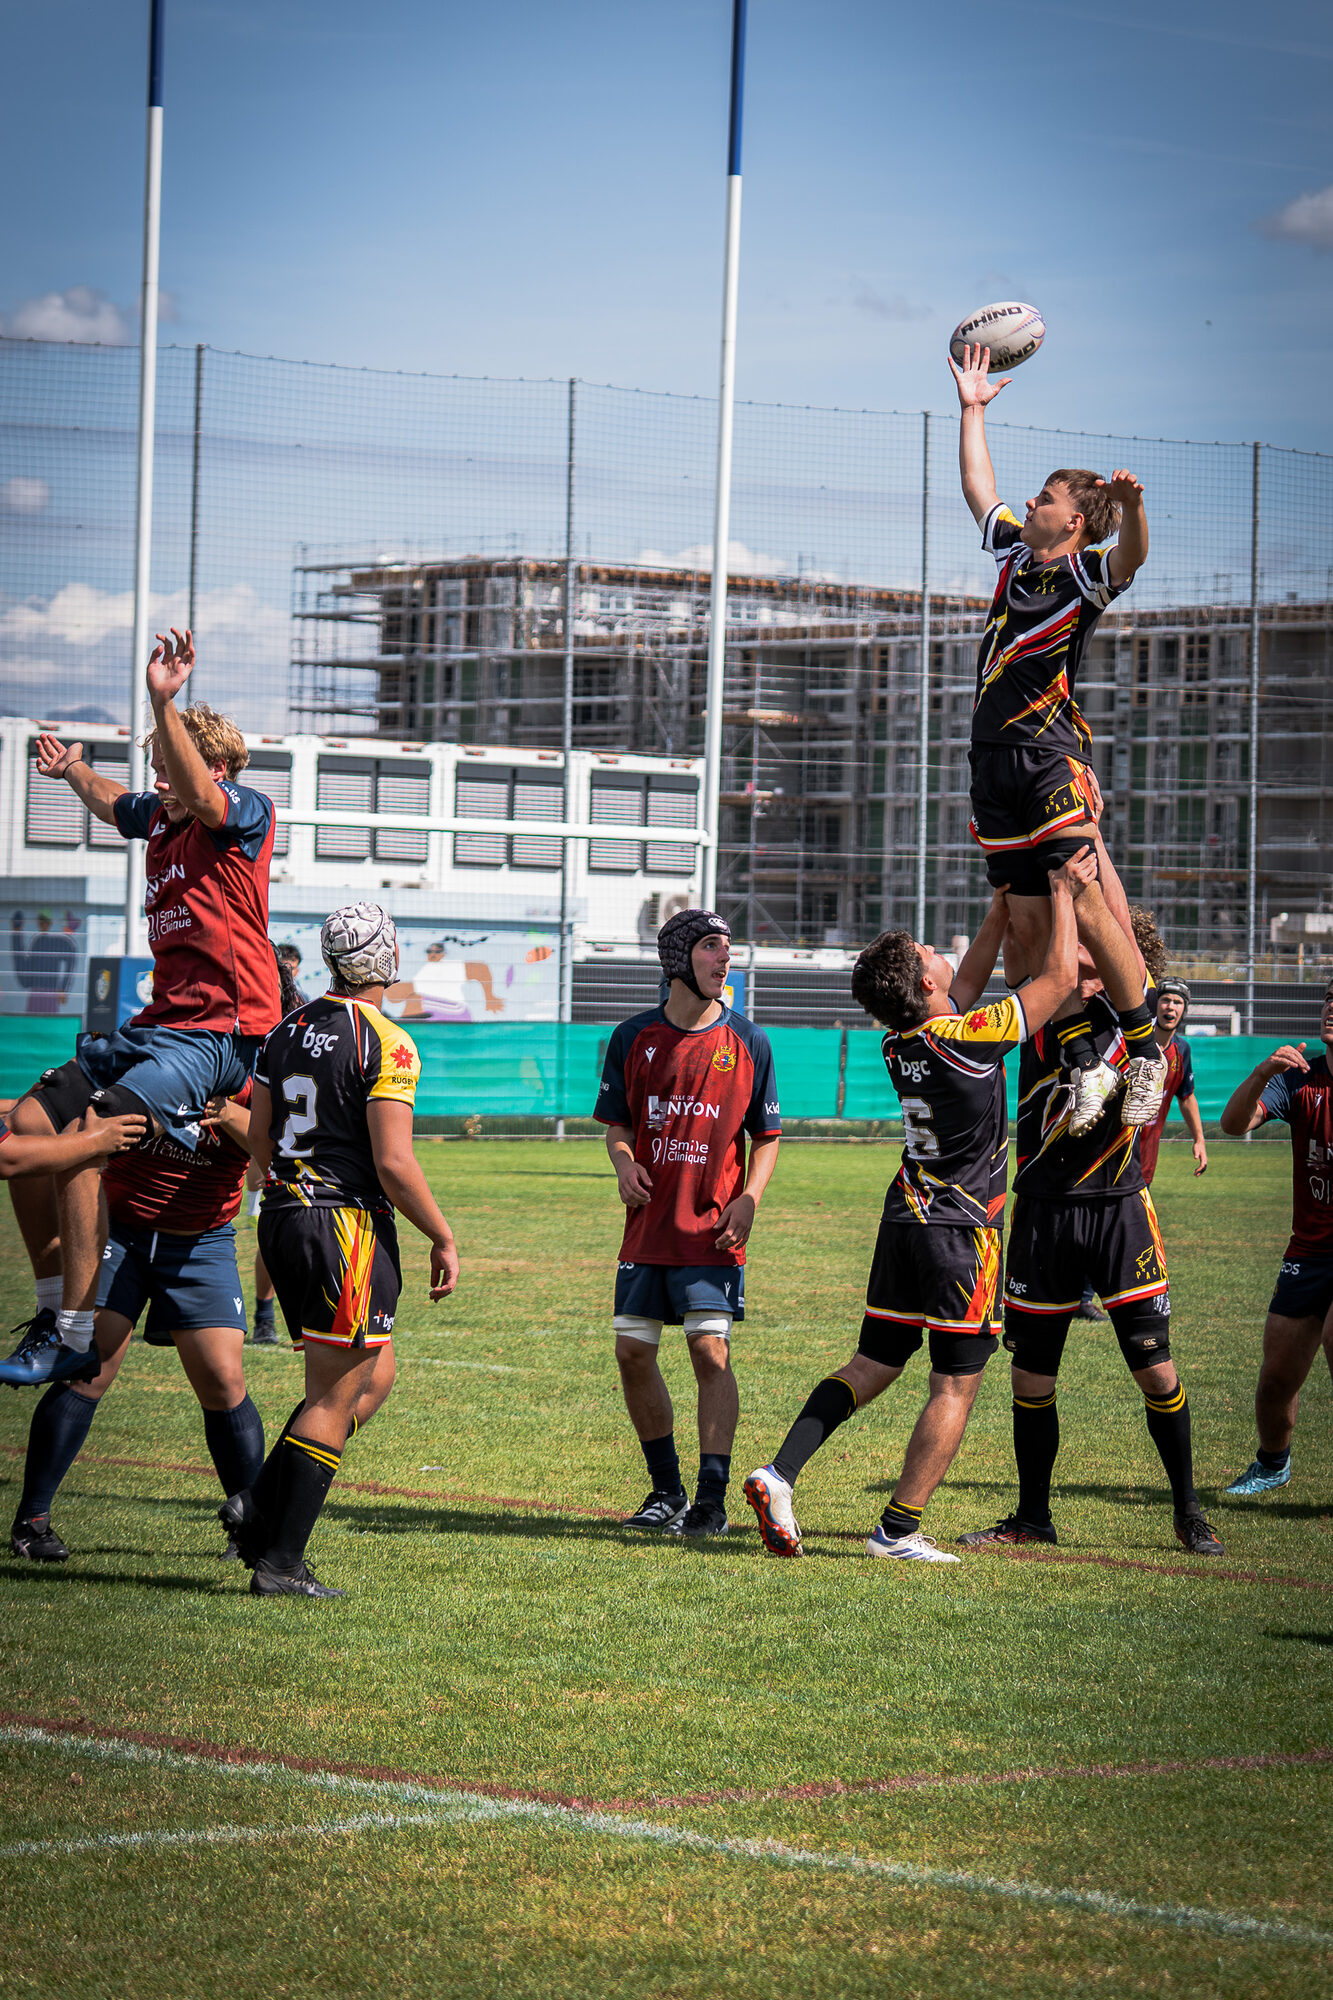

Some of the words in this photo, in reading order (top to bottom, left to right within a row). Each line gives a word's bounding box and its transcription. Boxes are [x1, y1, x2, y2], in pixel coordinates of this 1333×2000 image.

[960, 306, 1023, 337] RHINO
[988, 339, 1036, 369] HINO
[1044, 797, 1069, 814] PAC
[160, 905, 190, 923] Smile
[301, 1023, 340, 1058] bgc
[897, 1054, 932, 1083] bgc
[278, 1073, 318, 1158] 2
[667, 1100, 720, 1119] NYON
[900, 1096, 940, 1160] 6
[669, 1138, 709, 1154] Smile
[667, 1151, 707, 1165] Clinique
[1135, 1266, 1157, 1280] PAC
[1009, 1276, 1027, 1294] bgc
